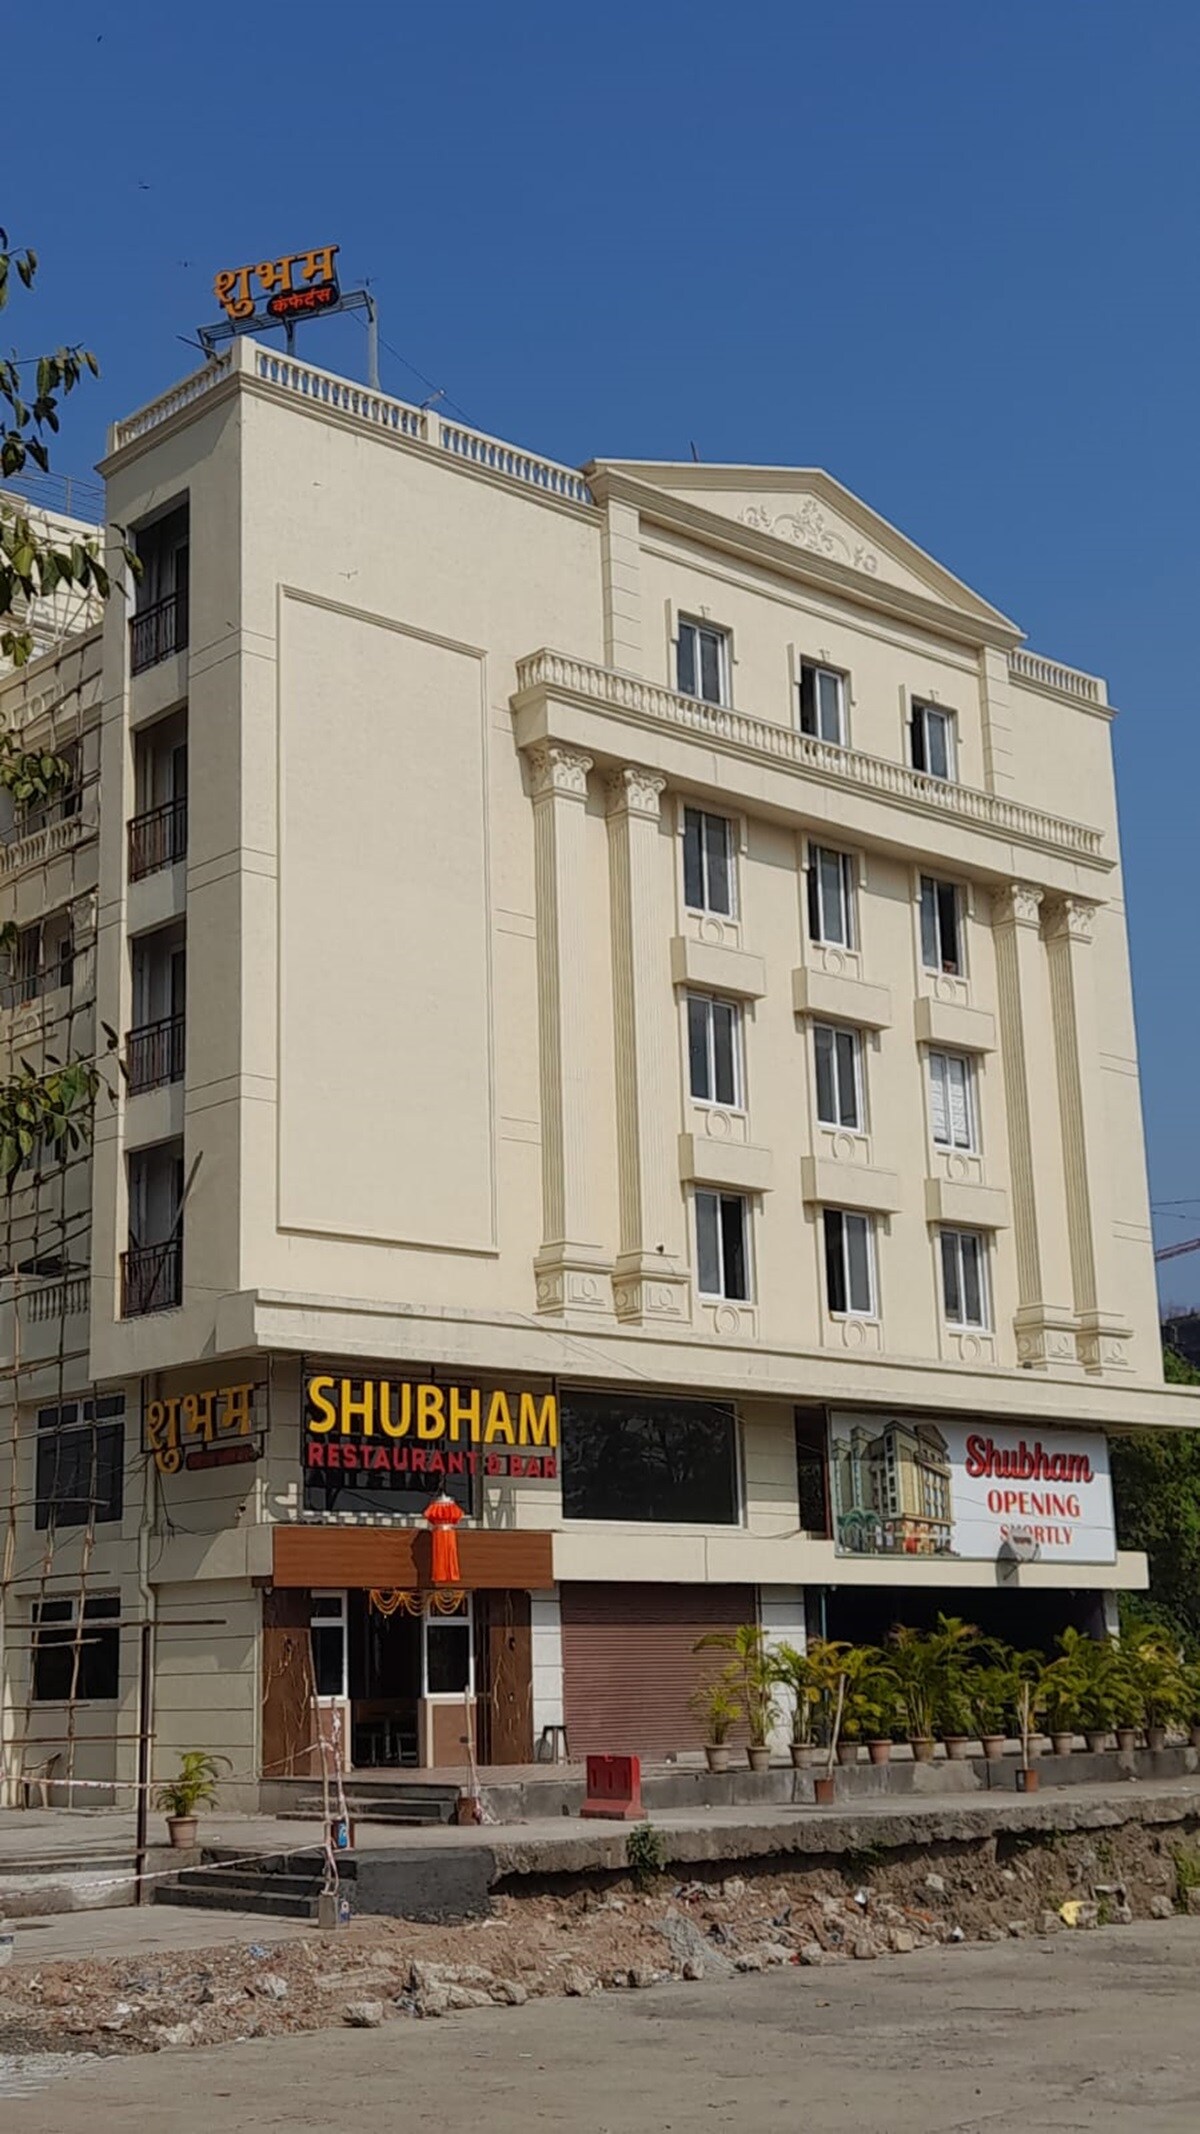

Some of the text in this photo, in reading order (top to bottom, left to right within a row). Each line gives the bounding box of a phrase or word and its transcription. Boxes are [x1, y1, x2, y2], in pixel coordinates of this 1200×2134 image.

[215, 245, 339, 319] शुभम
[148, 1383, 254, 1473] शुभम
[308, 1376, 557, 1447] SHUBHAM
[308, 1443, 557, 1478] RESTAURANT & BAR
[966, 1434, 1093, 1483] Shubham
[987, 1489, 1081, 1518] OPENING
